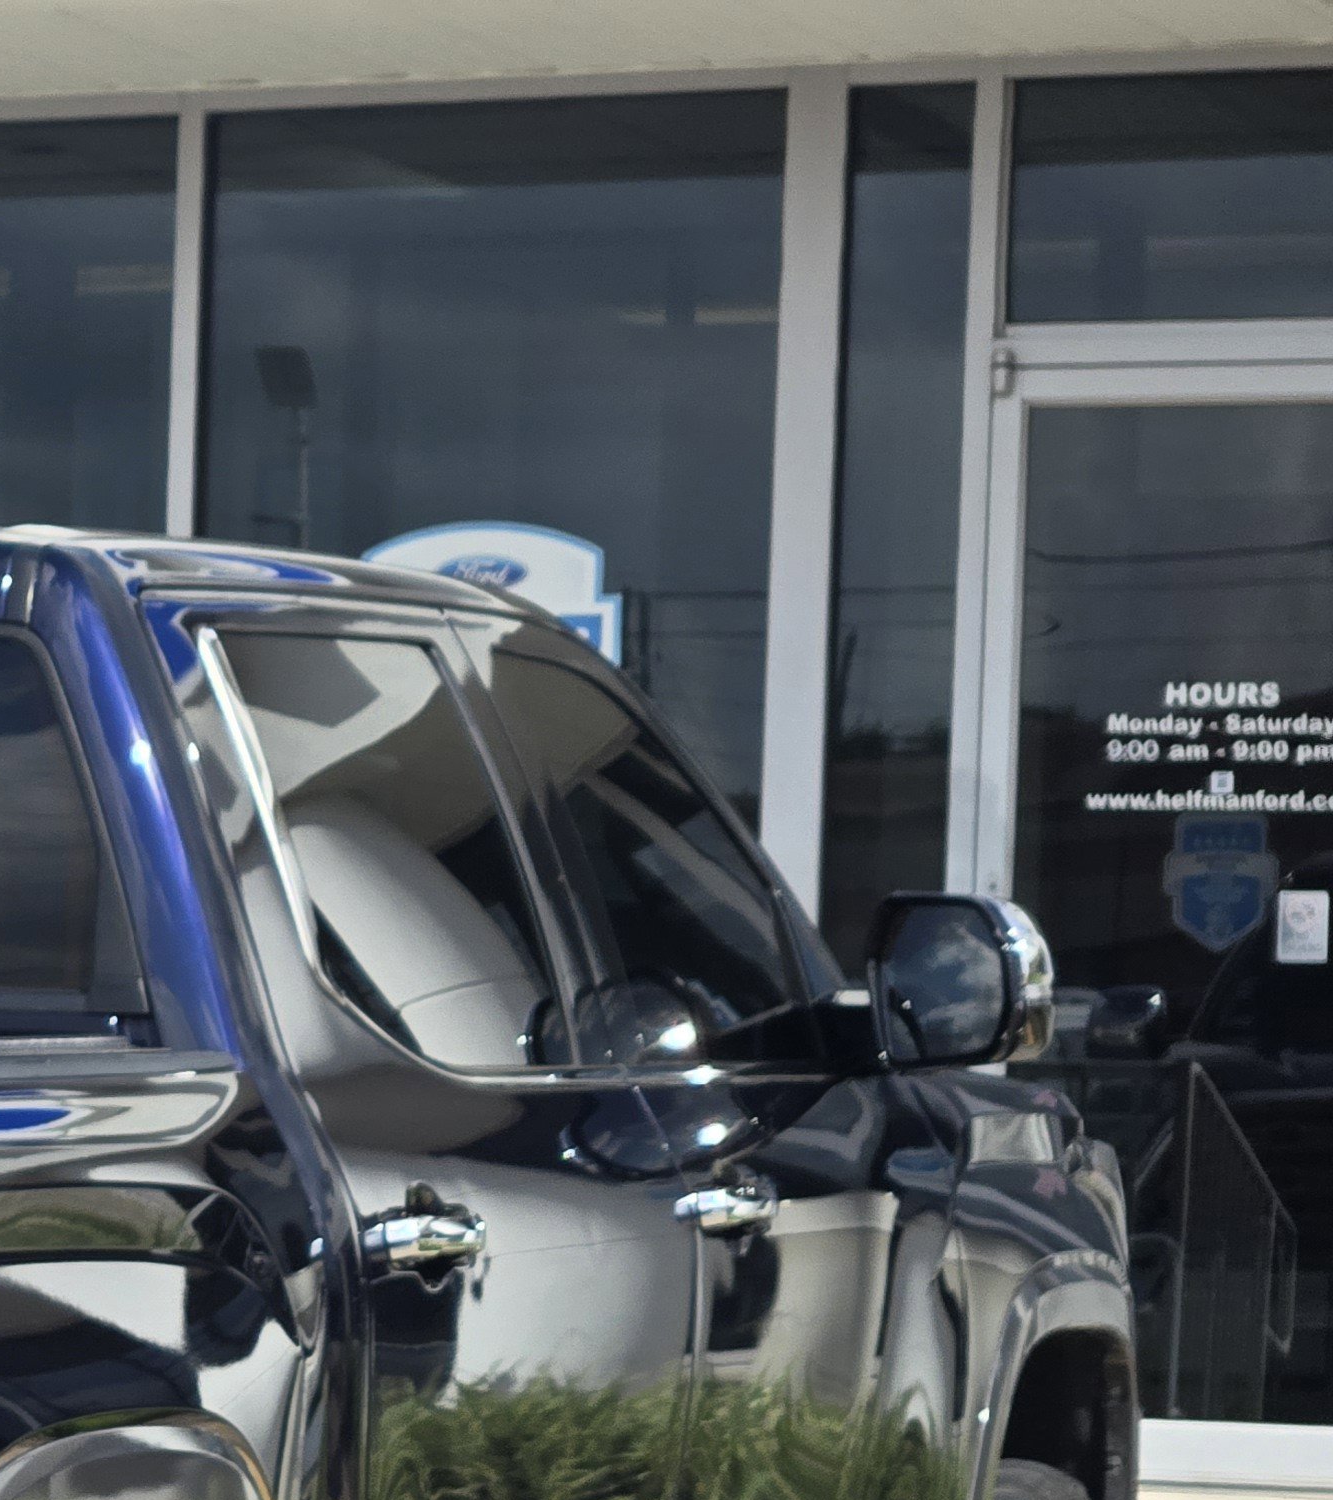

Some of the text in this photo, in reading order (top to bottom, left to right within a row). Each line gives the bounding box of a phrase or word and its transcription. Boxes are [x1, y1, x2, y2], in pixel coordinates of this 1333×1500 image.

[1164, 681, 1281, 707] HOURS
[1105, 712, 1203, 739] Monday
[1224, 713, 1333, 740] Saturday
[1105, 738, 1160, 763] 9:00
[1167, 744, 1210, 762] am
[1232, 739, 1290, 763] 9:00
